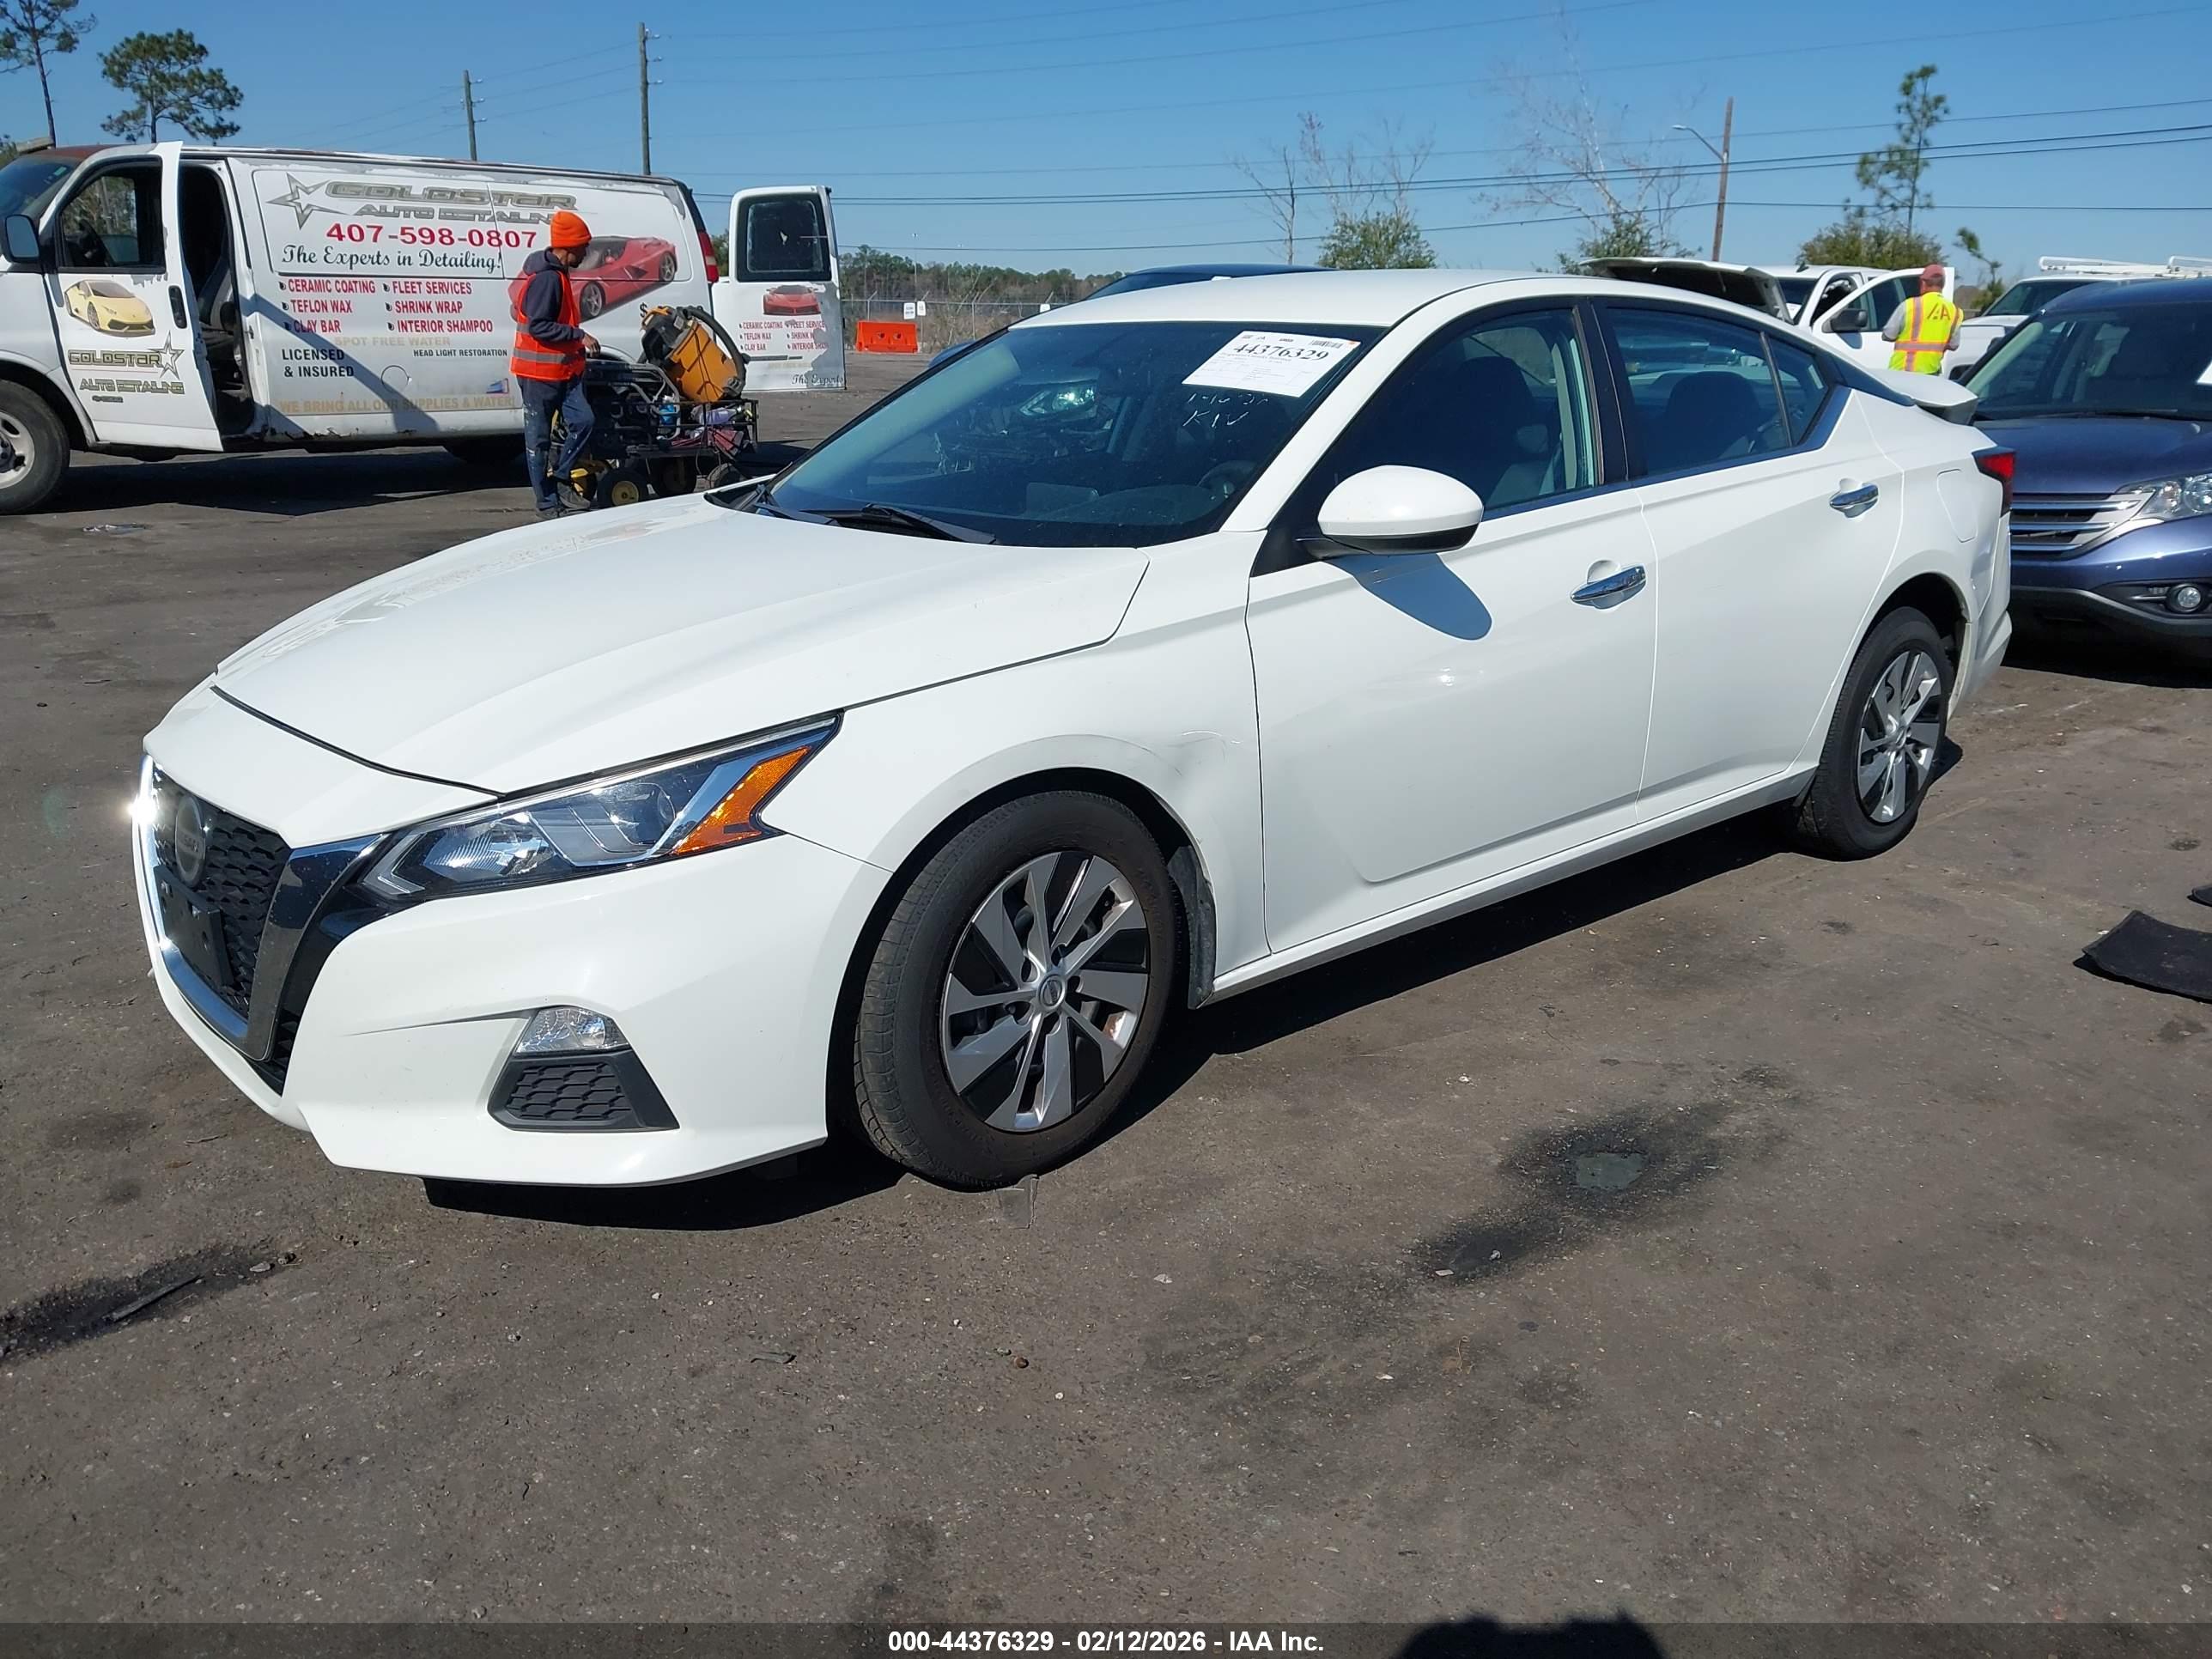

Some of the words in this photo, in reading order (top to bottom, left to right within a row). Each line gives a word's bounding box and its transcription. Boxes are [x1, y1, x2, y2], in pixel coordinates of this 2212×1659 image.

[325, 180, 579, 210] GOLDSTAR
[354, 204, 435, 221] AUTO
[326, 222, 537, 248] 407-598-0807
[282, 244, 318, 264] The
[324, 246, 390, 270] Experts
[397, 251, 413, 267] in
[419, 248, 502, 274] Detailing!
[288, 279, 332, 294] CERAMIC
[334, 280, 376, 294] COATING
[392, 281, 422, 295] FLEET
[425, 282, 472, 295] SERVICES
[290, 299, 329, 313] TEFLON
[329, 300, 353, 313] WAX
[394, 301, 435, 313] SHRINK
[435, 301, 463, 314] WRAP
[294, 319, 318, 333] CLAY
[320, 319, 342, 333] BAR
[397, 319, 445, 333] INTERIOR
[446, 320, 494, 333] SHAMPOO
[742, 321, 763, 330] CERAMIC
[763, 321, 783, 330] COATING
[805, 320, 825, 329] SERVICE
[372, 336, 405, 347] FREE
[407, 336, 451, 347] WATER
[791, 331, 808, 340] SHRINK
[413, 349, 433, 357] HEAD
[435, 349, 457, 357] LIGHT
[459, 349, 507, 357] RESTORATION
[756, 343, 766, 351] BAR
[1234, 343, 1329, 361] 44376329
[68, 349, 165, 368] GOLDSTAR
[282, 349, 344, 361] LICENSED
[283, 366, 294, 378] &
[298, 365, 355, 378] INSURED
[79, 378, 116, 392] AUTO
[279, 400, 300, 413] WE
[301, 399, 343, 412] BRING
[346, 398, 372, 412] ALL
[373, 398, 398, 411] OUR
[403, 397, 459, 410] SUPPLIES
